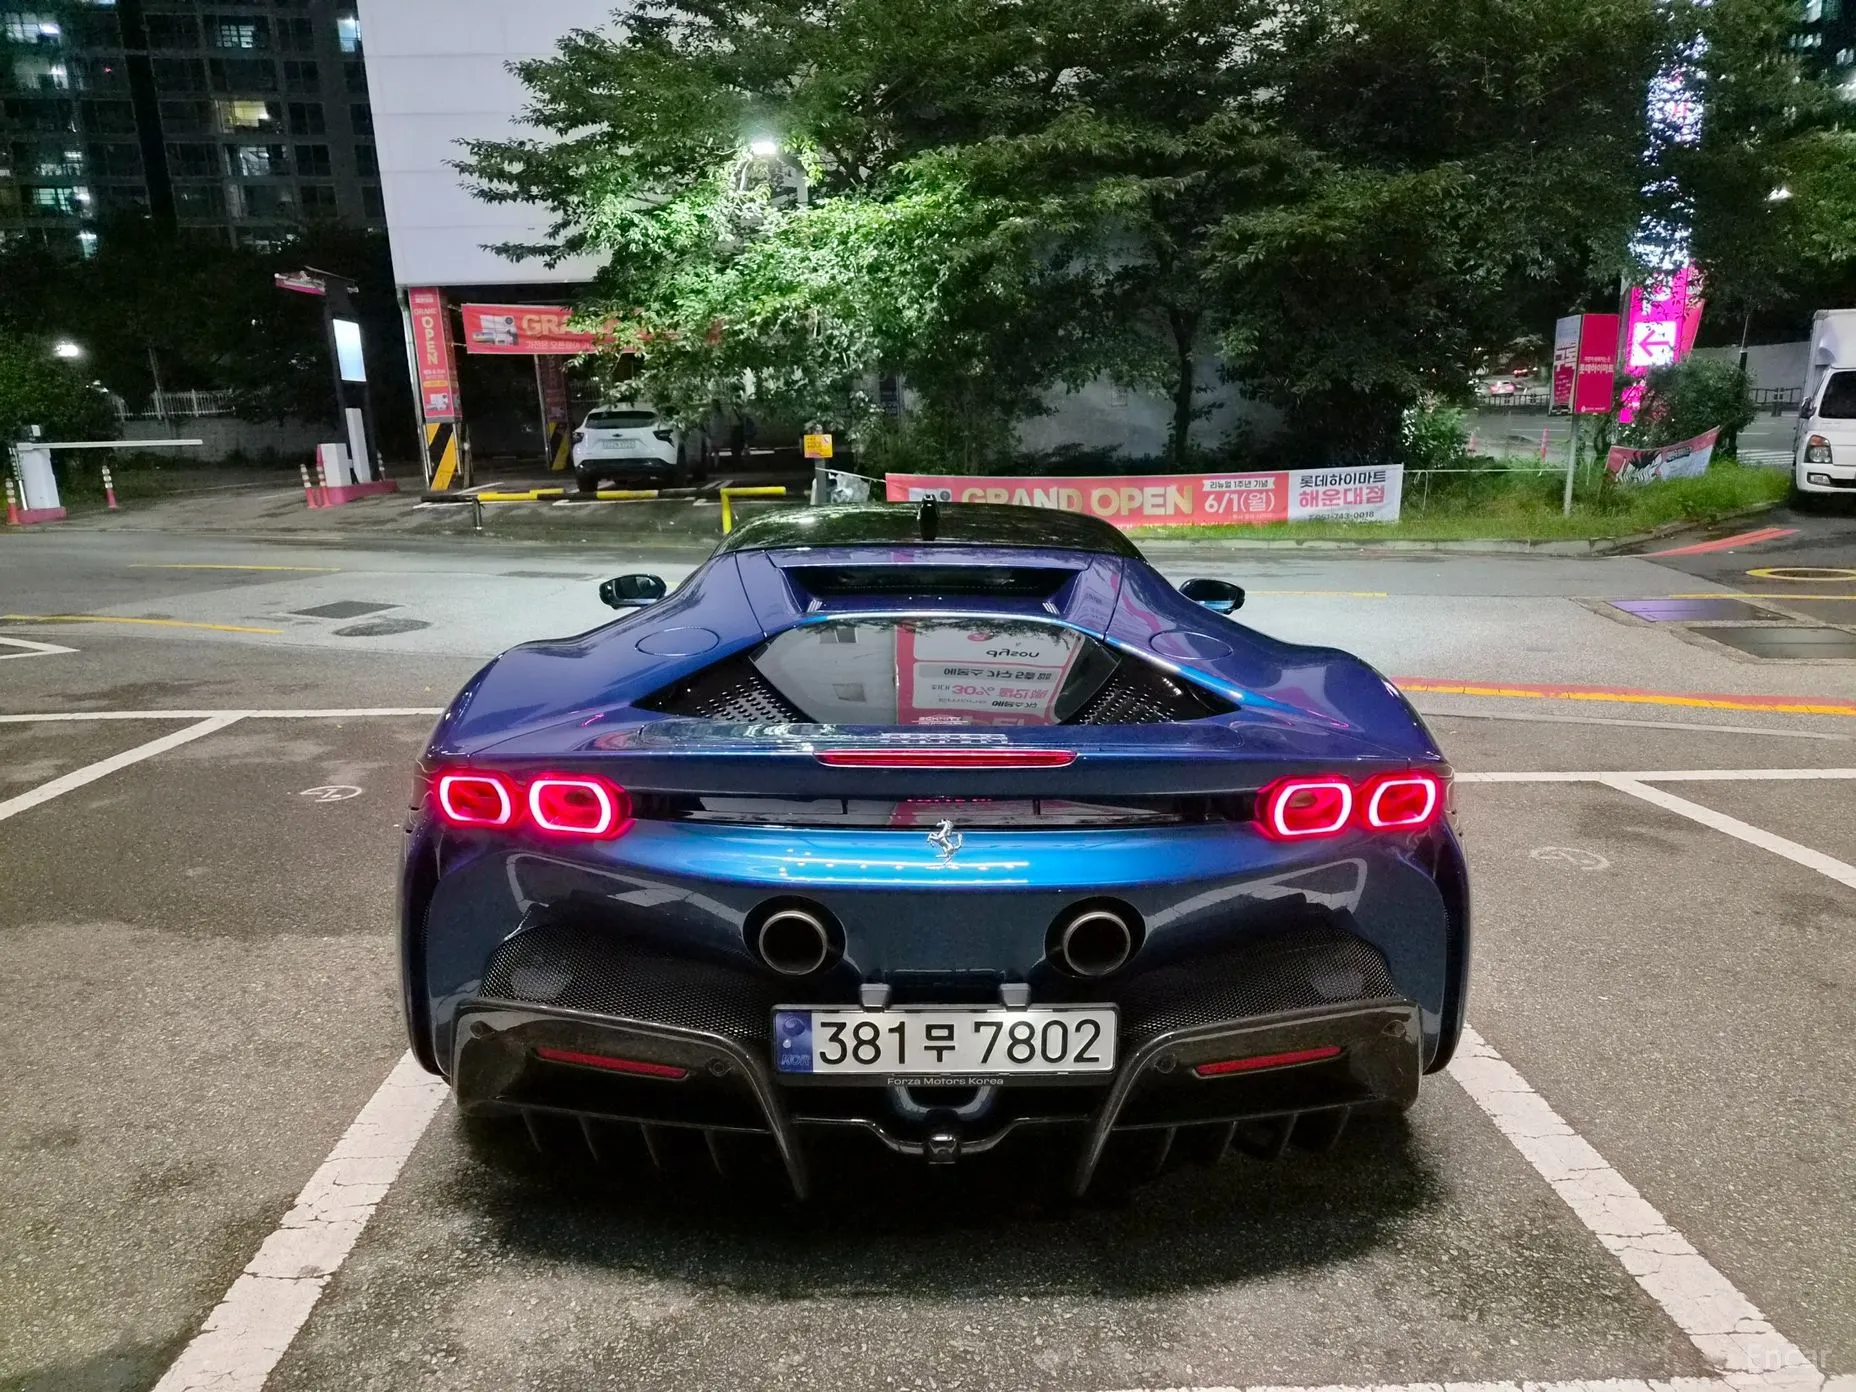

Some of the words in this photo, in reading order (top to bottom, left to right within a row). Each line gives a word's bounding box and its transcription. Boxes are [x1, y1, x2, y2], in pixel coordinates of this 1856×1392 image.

[421, 316, 439, 366] OPEN
[1209, 479, 1231, 489] 리뉴얼
[1233, 479, 1252, 489] 1주년
[1253, 479, 1269, 488] 기념
[1300, 470, 1387, 489] 롯데하이마트
[961, 486, 1083, 513] GRAND
[1090, 485, 1194, 517] OPEN
[1204, 490, 1276, 514] 6/1(월)
[1299, 485, 1386, 509] 해운대점
[887, 1077, 921, 1086] Forza
[923, 1077, 966, 1086] Motors
[968, 1077, 1004, 1086] Korea
